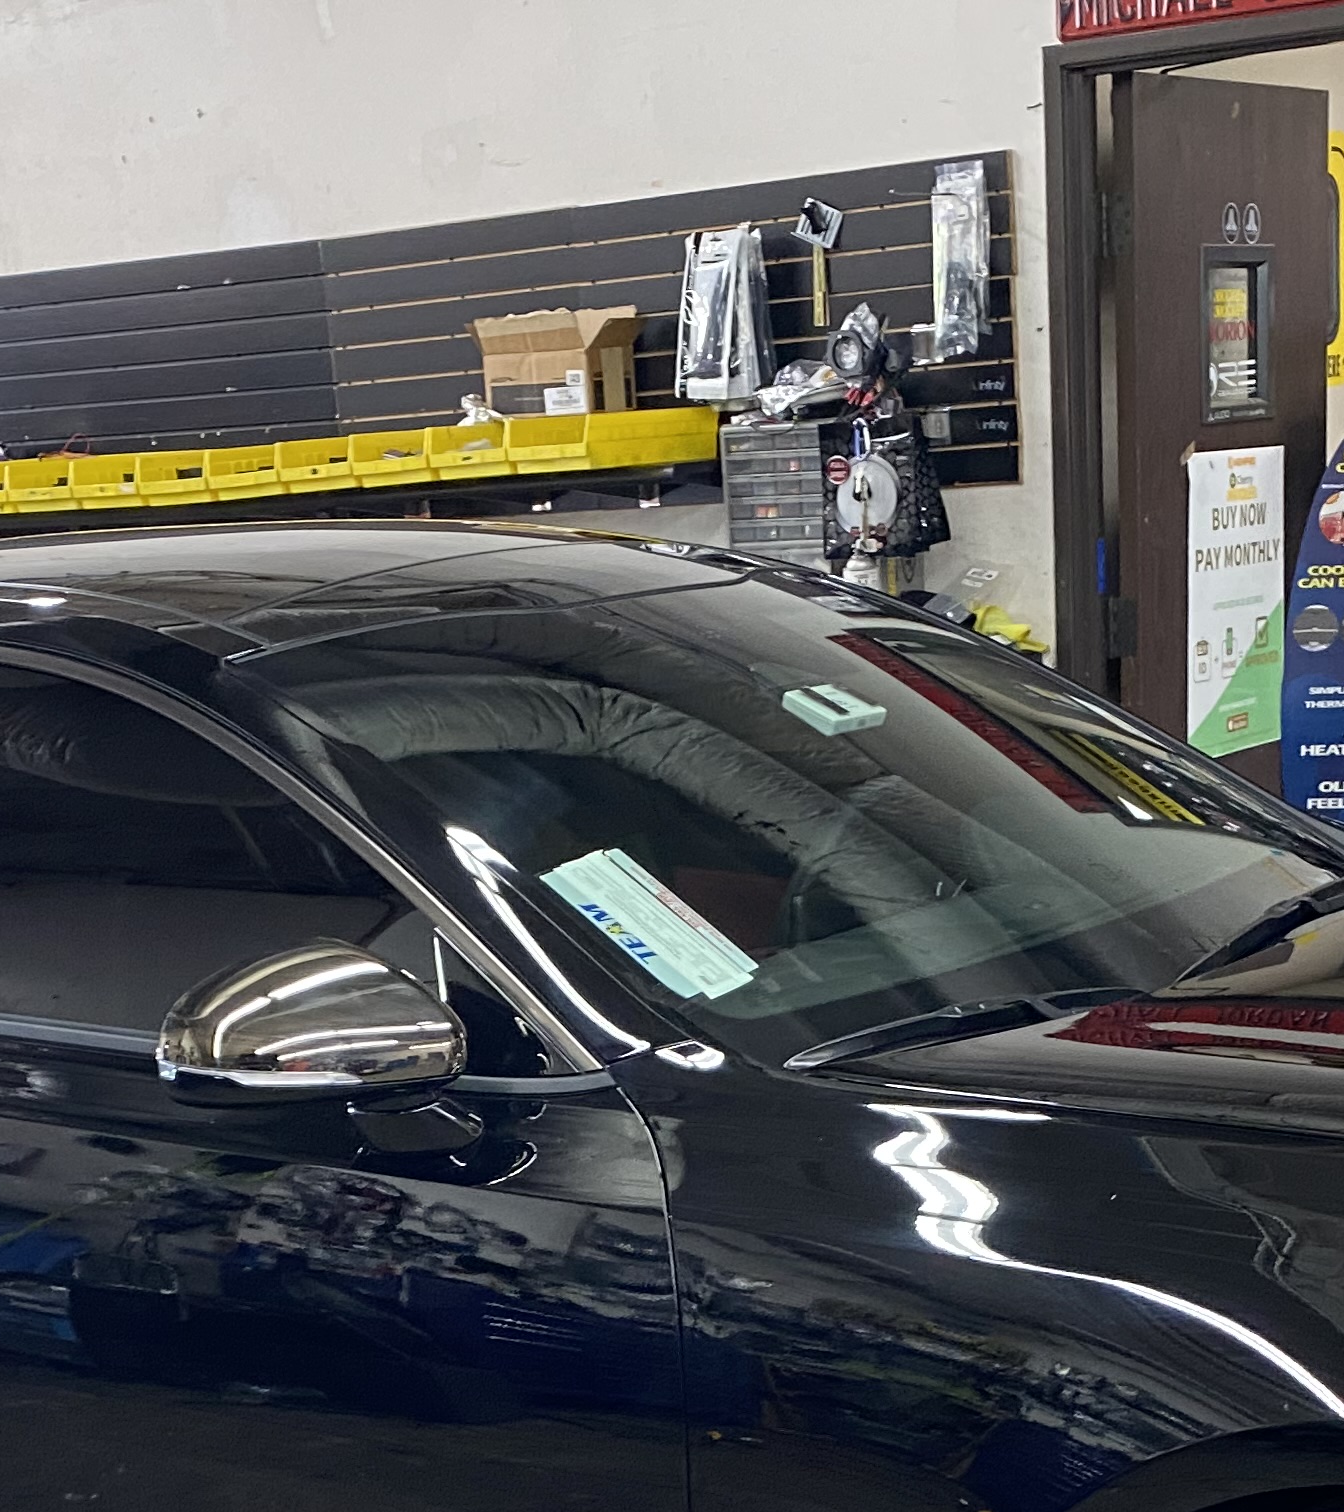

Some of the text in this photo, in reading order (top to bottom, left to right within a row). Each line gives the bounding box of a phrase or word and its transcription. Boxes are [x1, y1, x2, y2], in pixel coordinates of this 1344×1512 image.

[1212, 503, 1267, 530] BUY NOW
[1195, 538, 1281, 572] PAY MONTHLY
[1297, 577, 1335, 589] CAN
